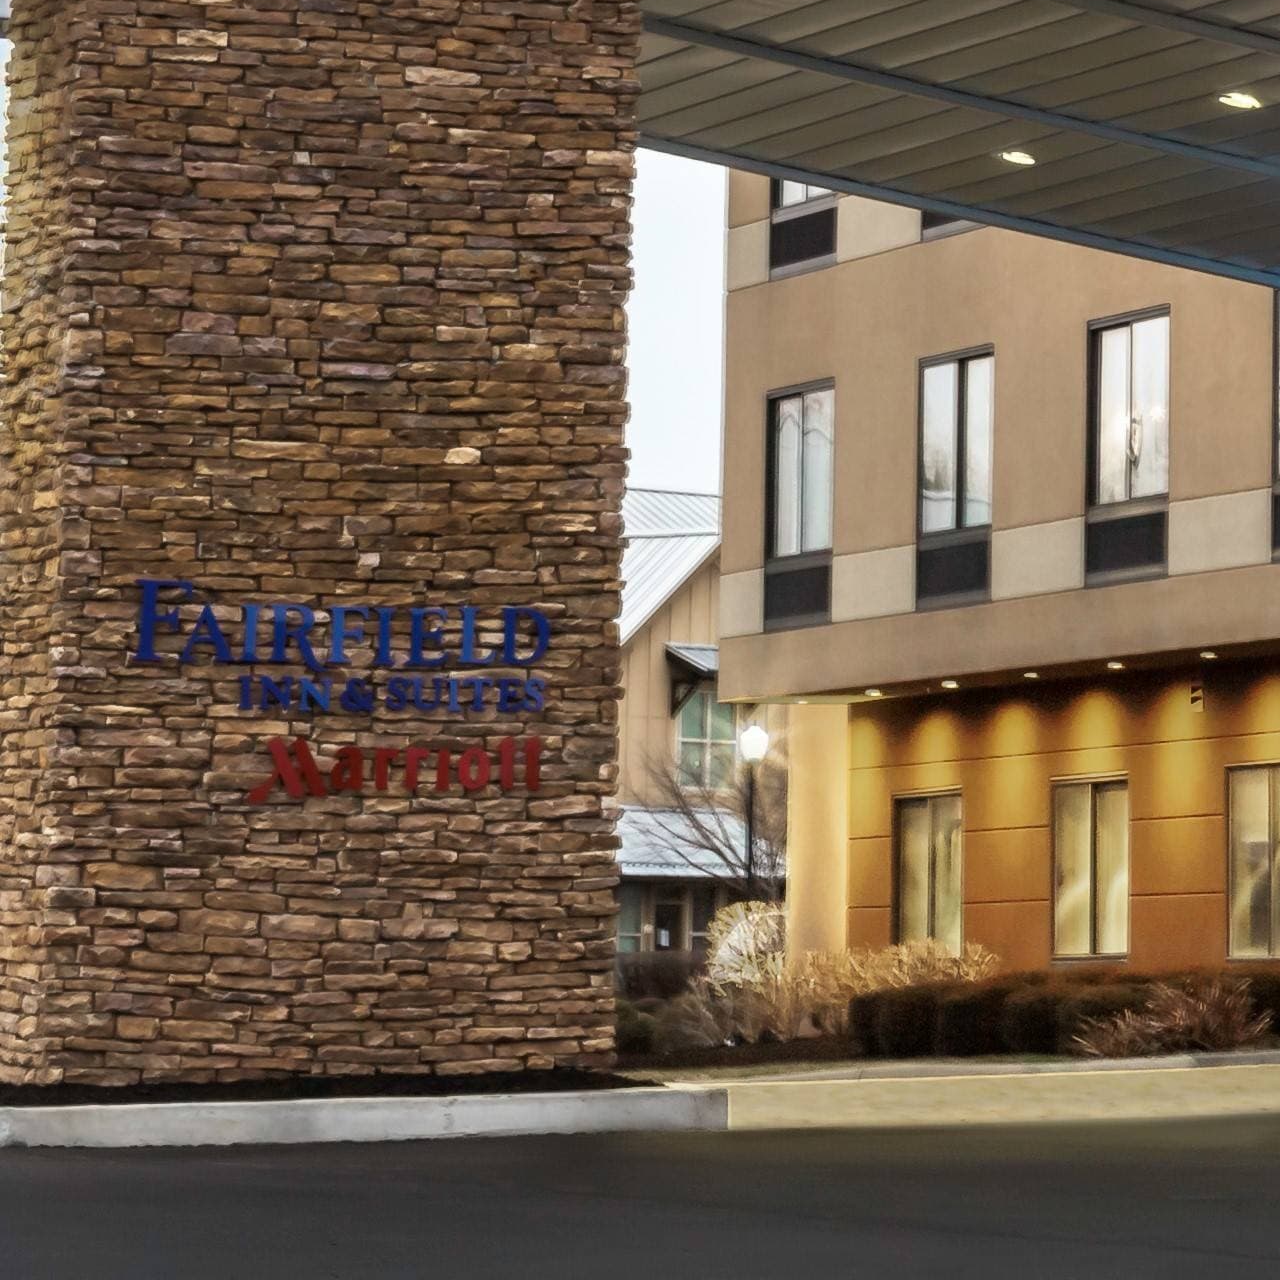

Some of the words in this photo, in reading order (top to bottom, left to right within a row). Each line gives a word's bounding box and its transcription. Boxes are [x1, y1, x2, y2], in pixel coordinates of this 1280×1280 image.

[134, 579, 551, 673] FAIRFIELD
[239, 675, 332, 712] INN
[340, 677, 375, 712] &
[385, 677, 546, 712] SUITES
[247, 736, 542, 805] Marriott
